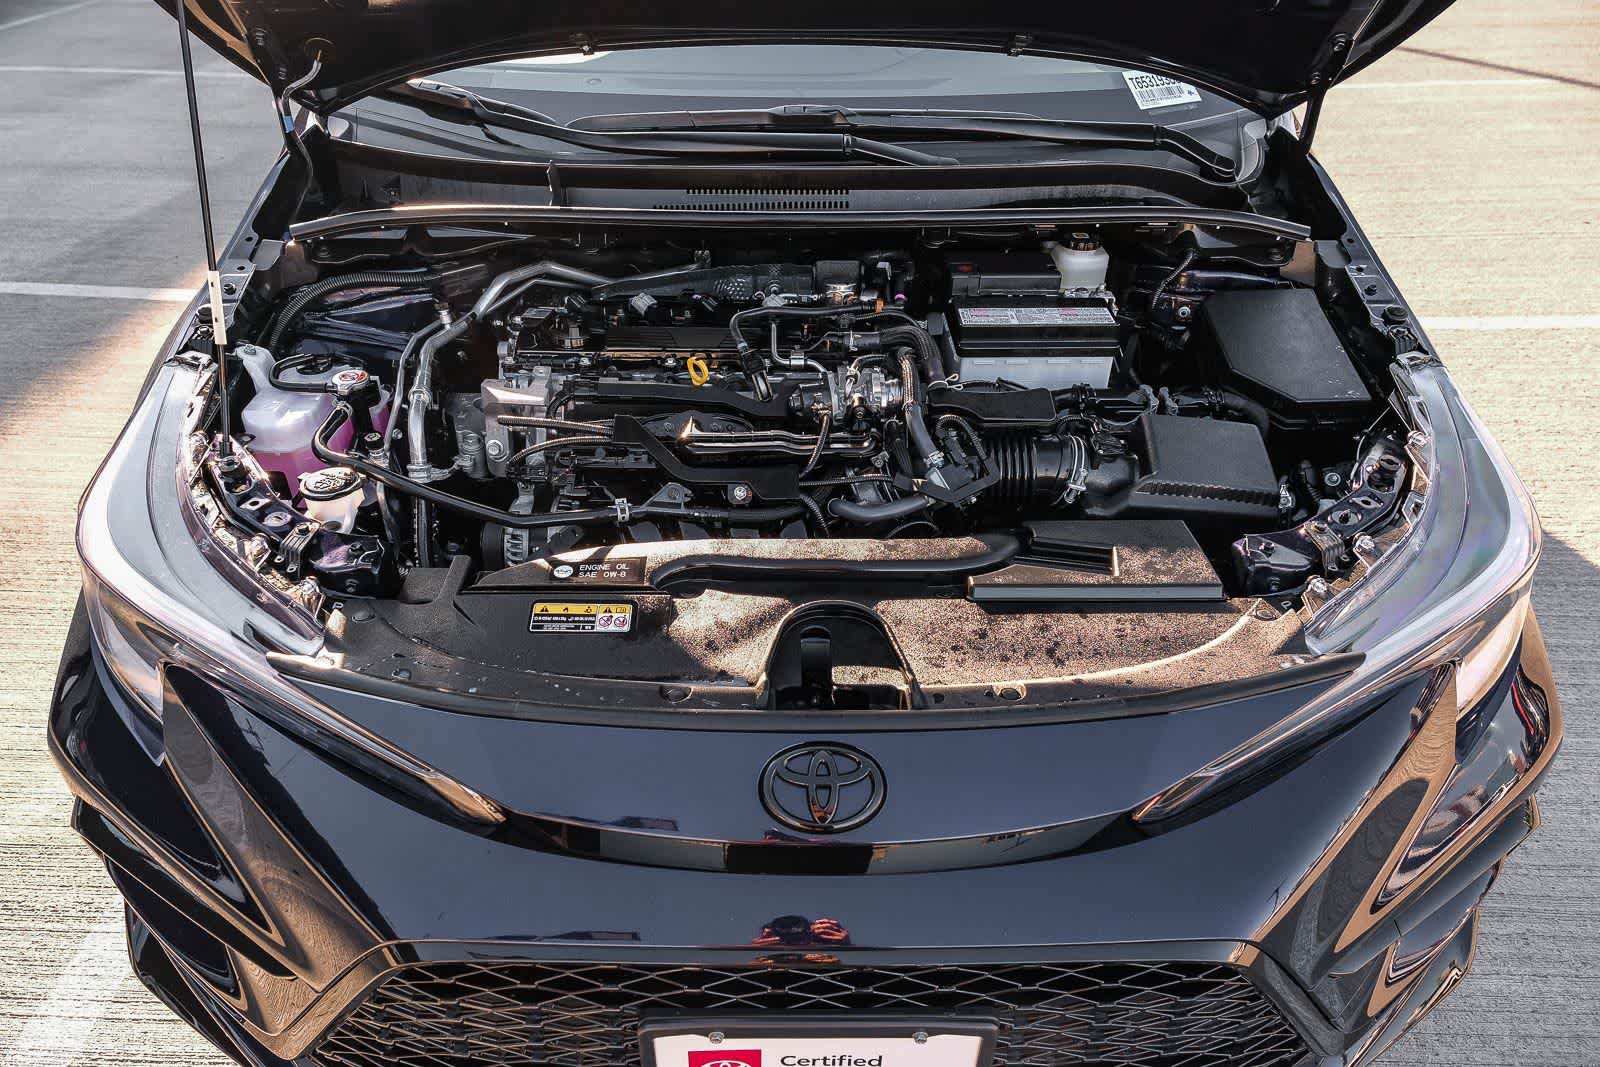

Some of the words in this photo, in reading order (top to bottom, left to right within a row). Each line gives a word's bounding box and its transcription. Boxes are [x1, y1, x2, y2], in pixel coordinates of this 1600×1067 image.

[1128, 75, 1180, 89] T65319
[579, 563, 611, 571] ENGINE
[780, 1055, 883, 1067] Certified
